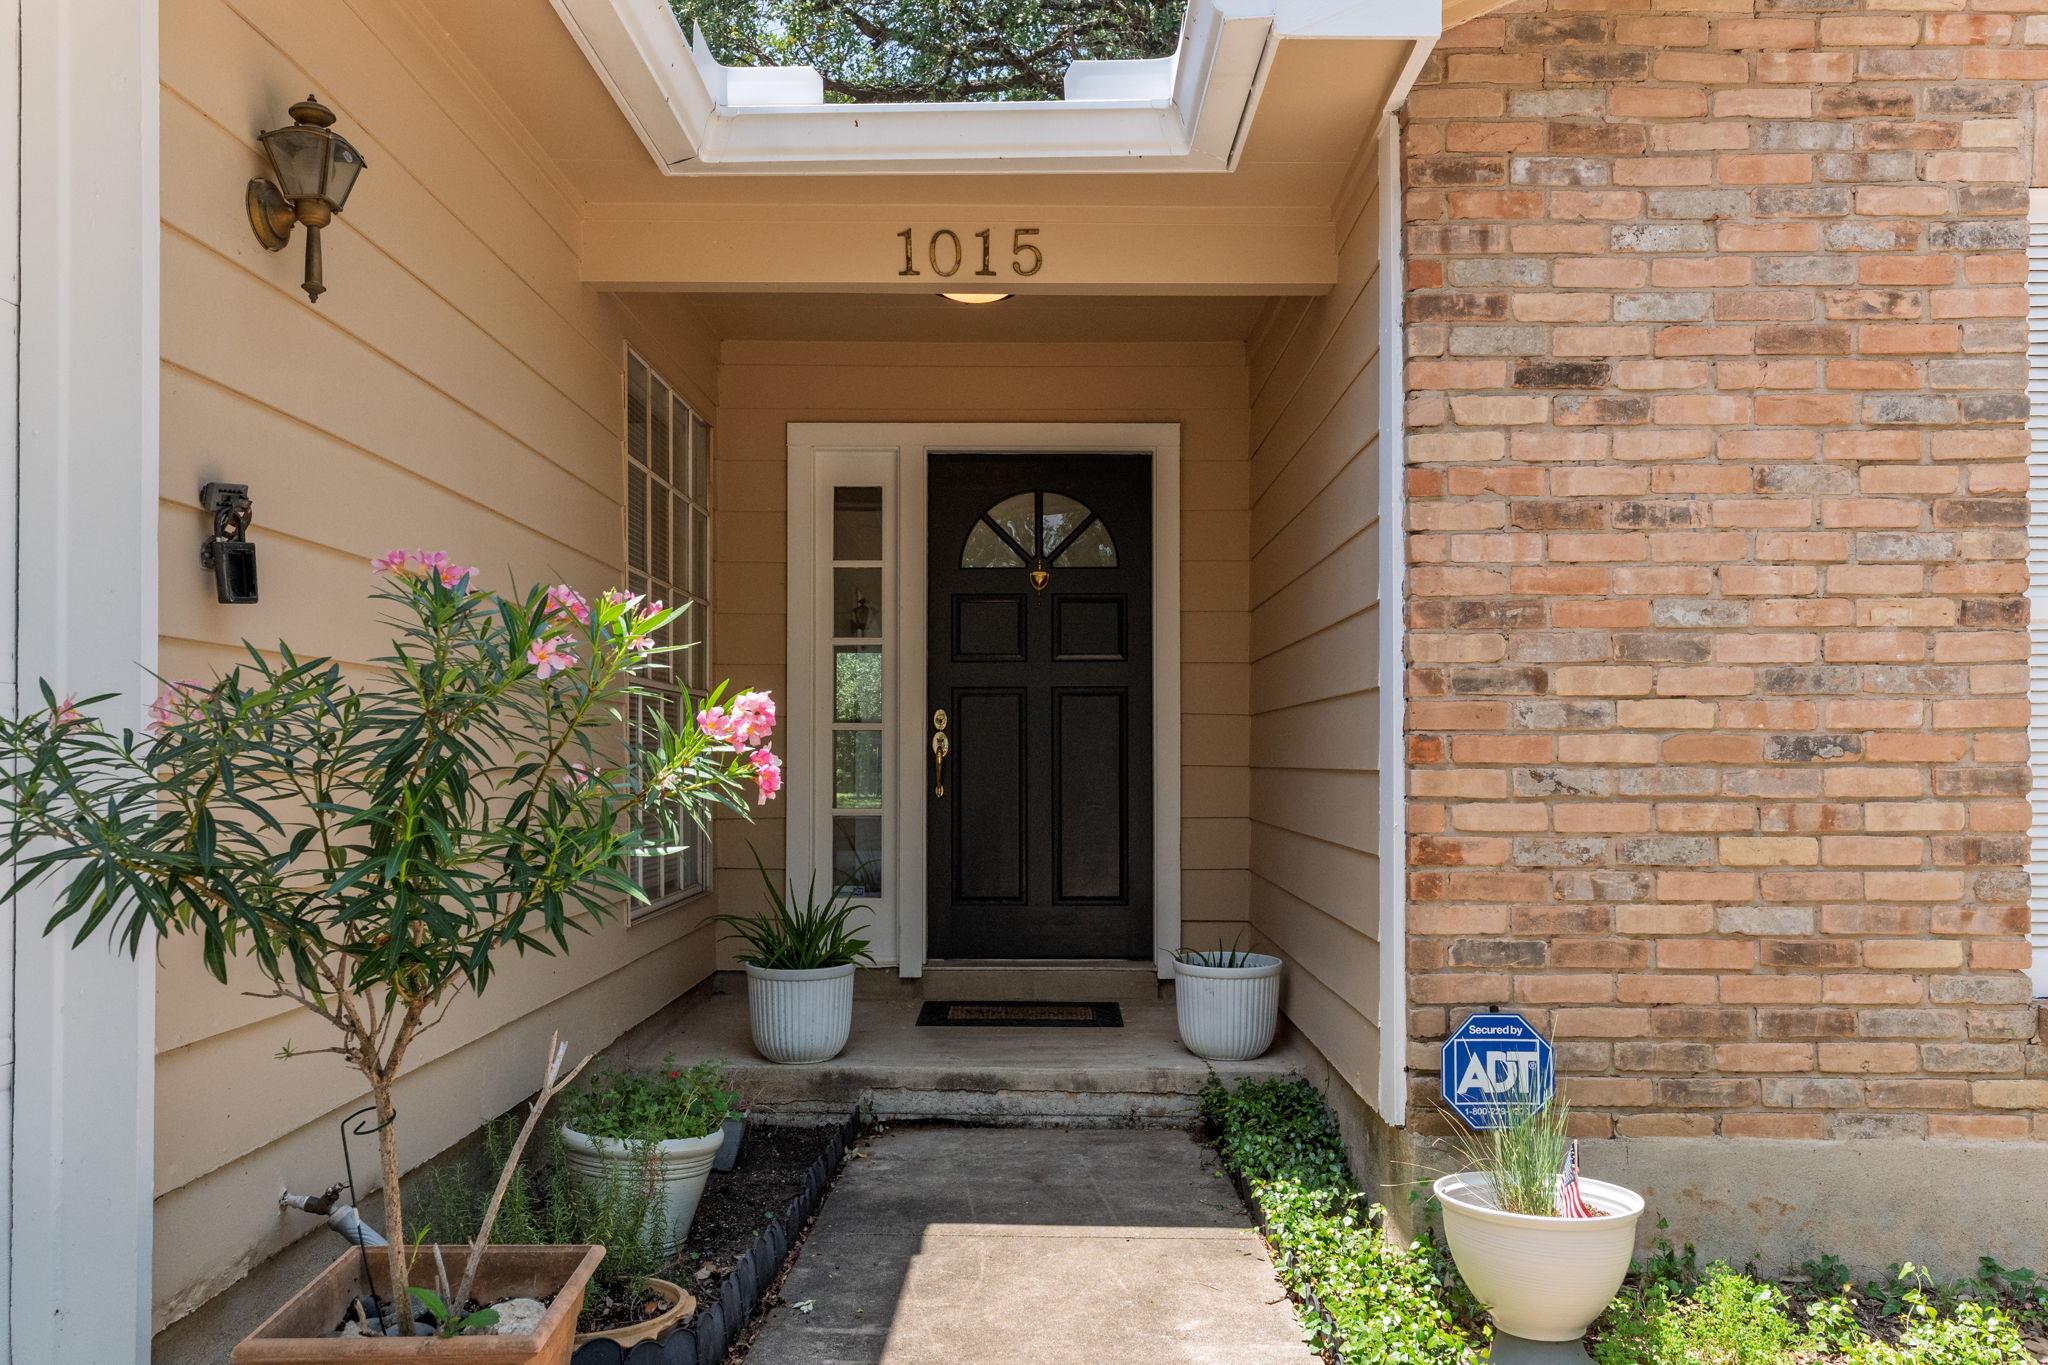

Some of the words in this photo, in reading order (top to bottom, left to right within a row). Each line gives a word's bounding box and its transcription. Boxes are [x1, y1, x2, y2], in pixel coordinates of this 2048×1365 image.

[897, 228, 1043, 277] 1015
[1469, 1025, 1509, 1035] Secured
[1510, 1025, 1523, 1036] by
